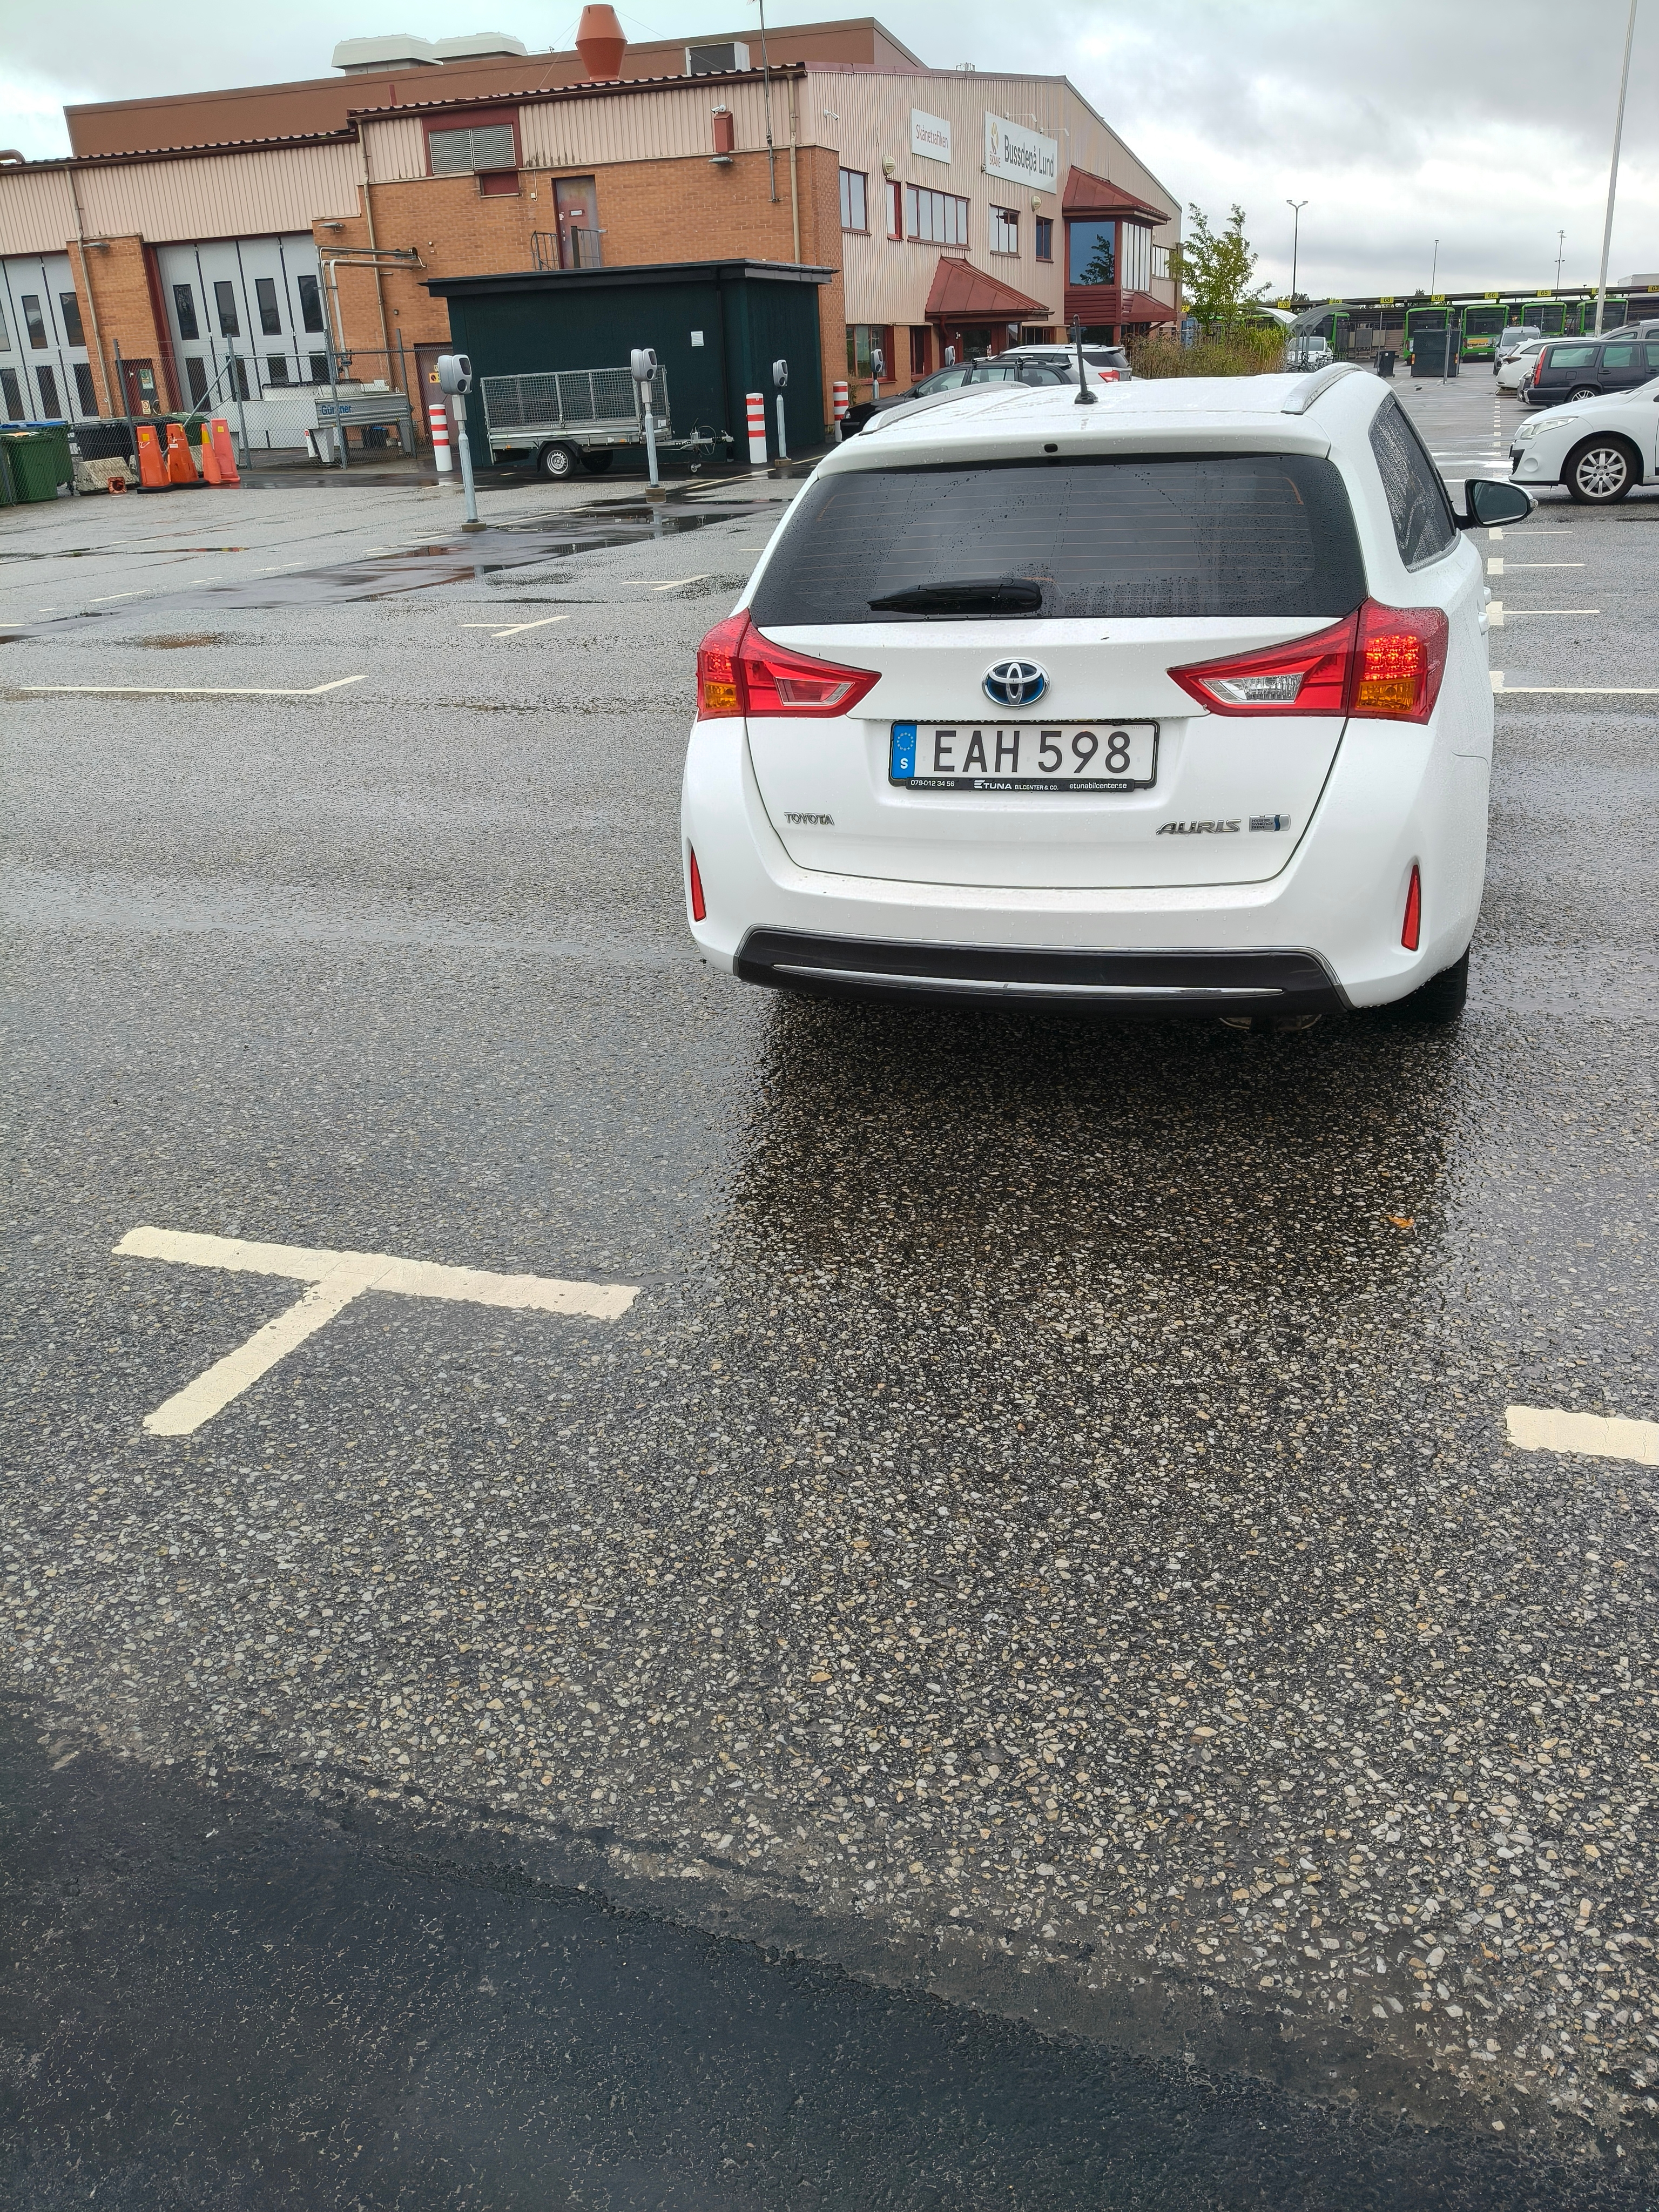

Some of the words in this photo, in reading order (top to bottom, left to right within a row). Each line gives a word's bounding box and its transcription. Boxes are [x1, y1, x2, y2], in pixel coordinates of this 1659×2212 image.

[916, 124, 949, 149] Skånetrafiken
[1004, 134, 1037, 177] Bussdepå
[1038, 148, 1054, 178] Lund
[933, 730, 1020, 773] EAH
[1038, 731, 1131, 773] 598
[900, 758, 908, 770] S
[974, 780, 1012, 790] ETUNA
[783, 812, 835, 826] TOYOTA
[1156, 819, 1242, 835] AURIS
